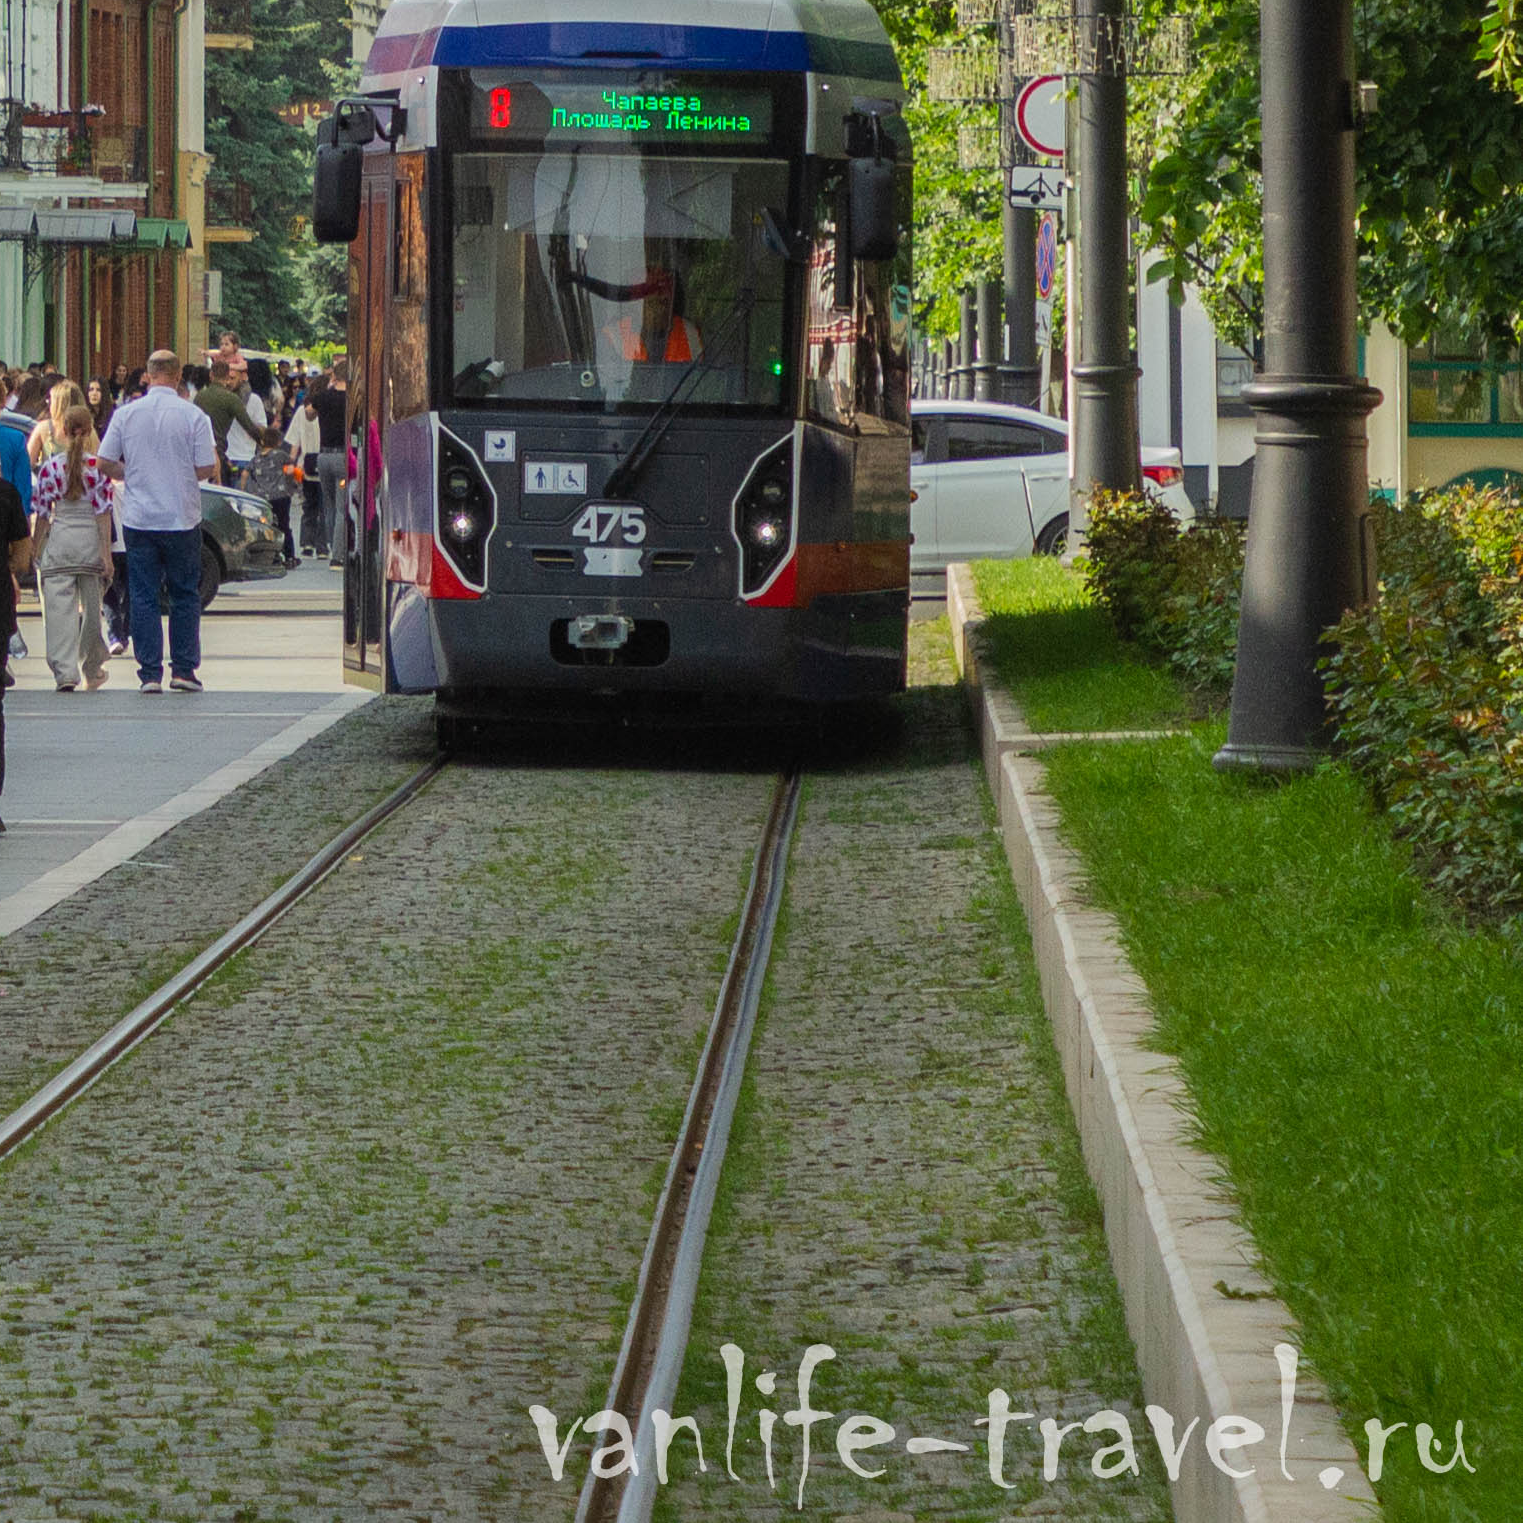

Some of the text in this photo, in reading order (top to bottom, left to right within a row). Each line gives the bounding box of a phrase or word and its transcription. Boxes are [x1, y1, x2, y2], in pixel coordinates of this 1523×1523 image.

[490, 87, 511, 128] 8
[602, 90, 702, 112] Чапаева
[552, 107, 751, 132] Площадь Ленина
[572, 505, 647, 544] 475
